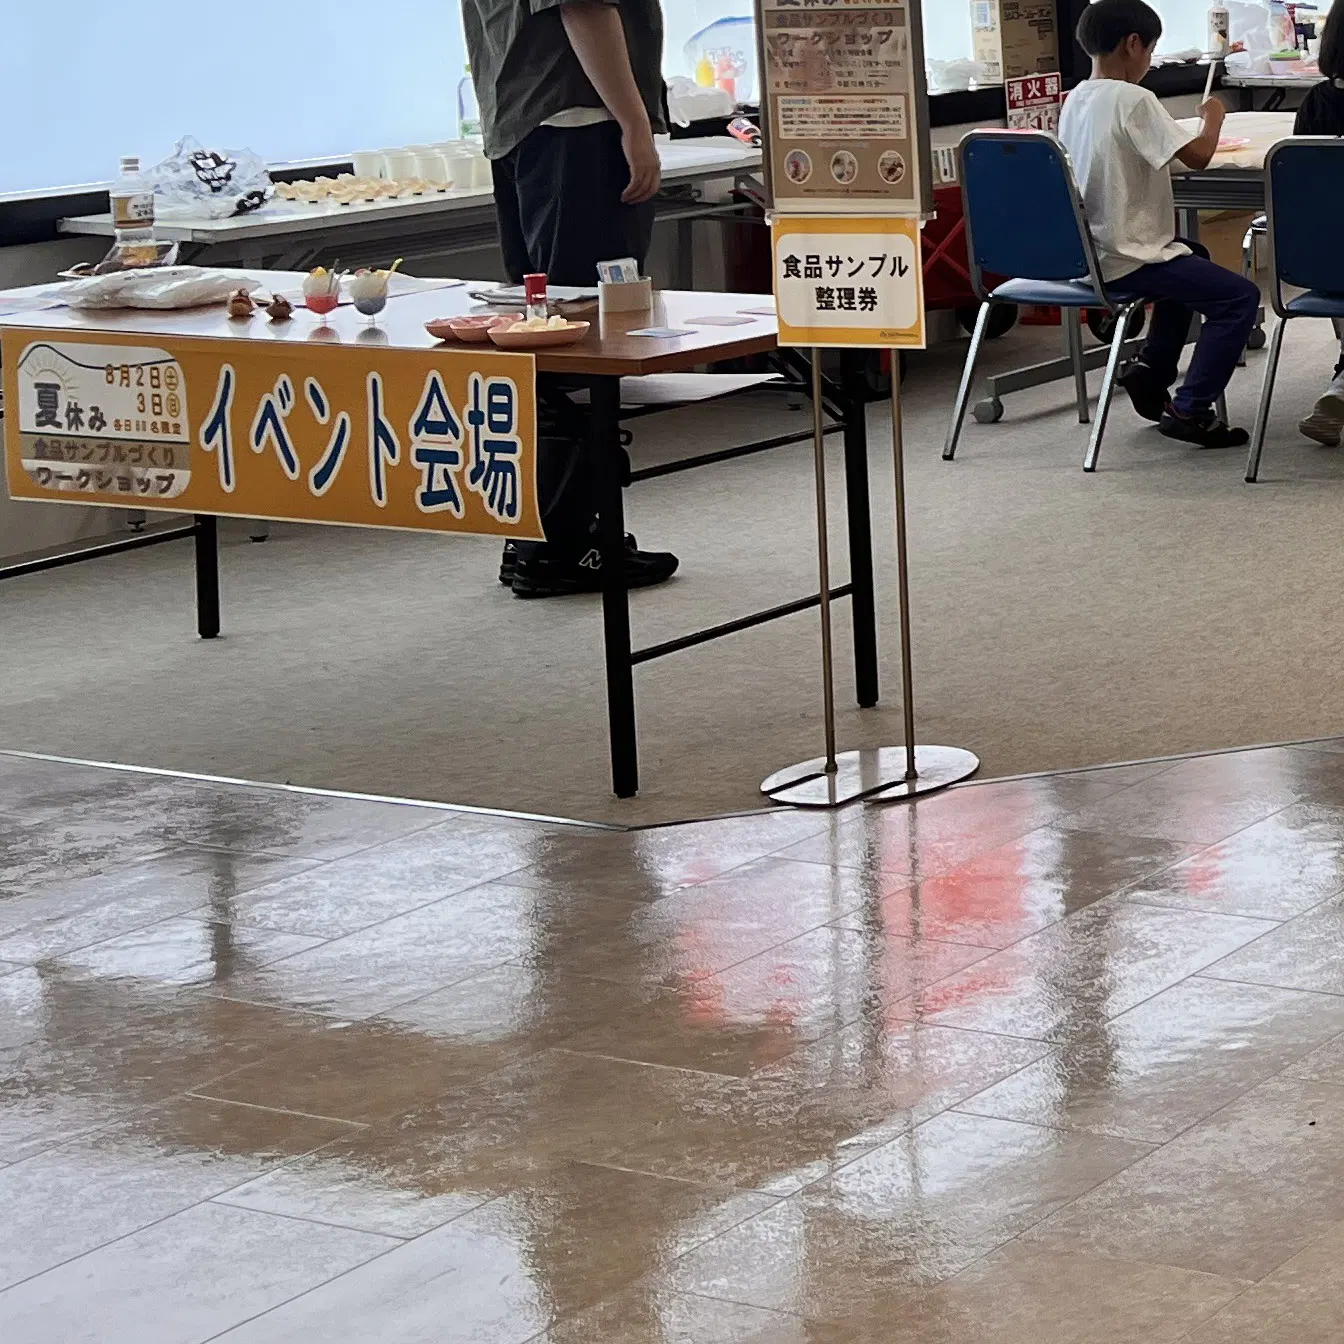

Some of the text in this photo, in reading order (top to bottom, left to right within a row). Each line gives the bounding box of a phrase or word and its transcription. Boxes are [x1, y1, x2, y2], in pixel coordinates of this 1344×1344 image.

[777, 29, 893, 46] ワークショップ
[1009, 77, 1058, 101] 消火器
[782, 253, 909, 280] 食品サンプル
[815, 286, 878, 312] 整理券
[33, 382, 108, 432] 夏休み
[33, 437, 174, 467] 食品サンプルづくり
[202, 364, 521, 522] イベント会場
[36, 467, 175, 494] ワークショップ
